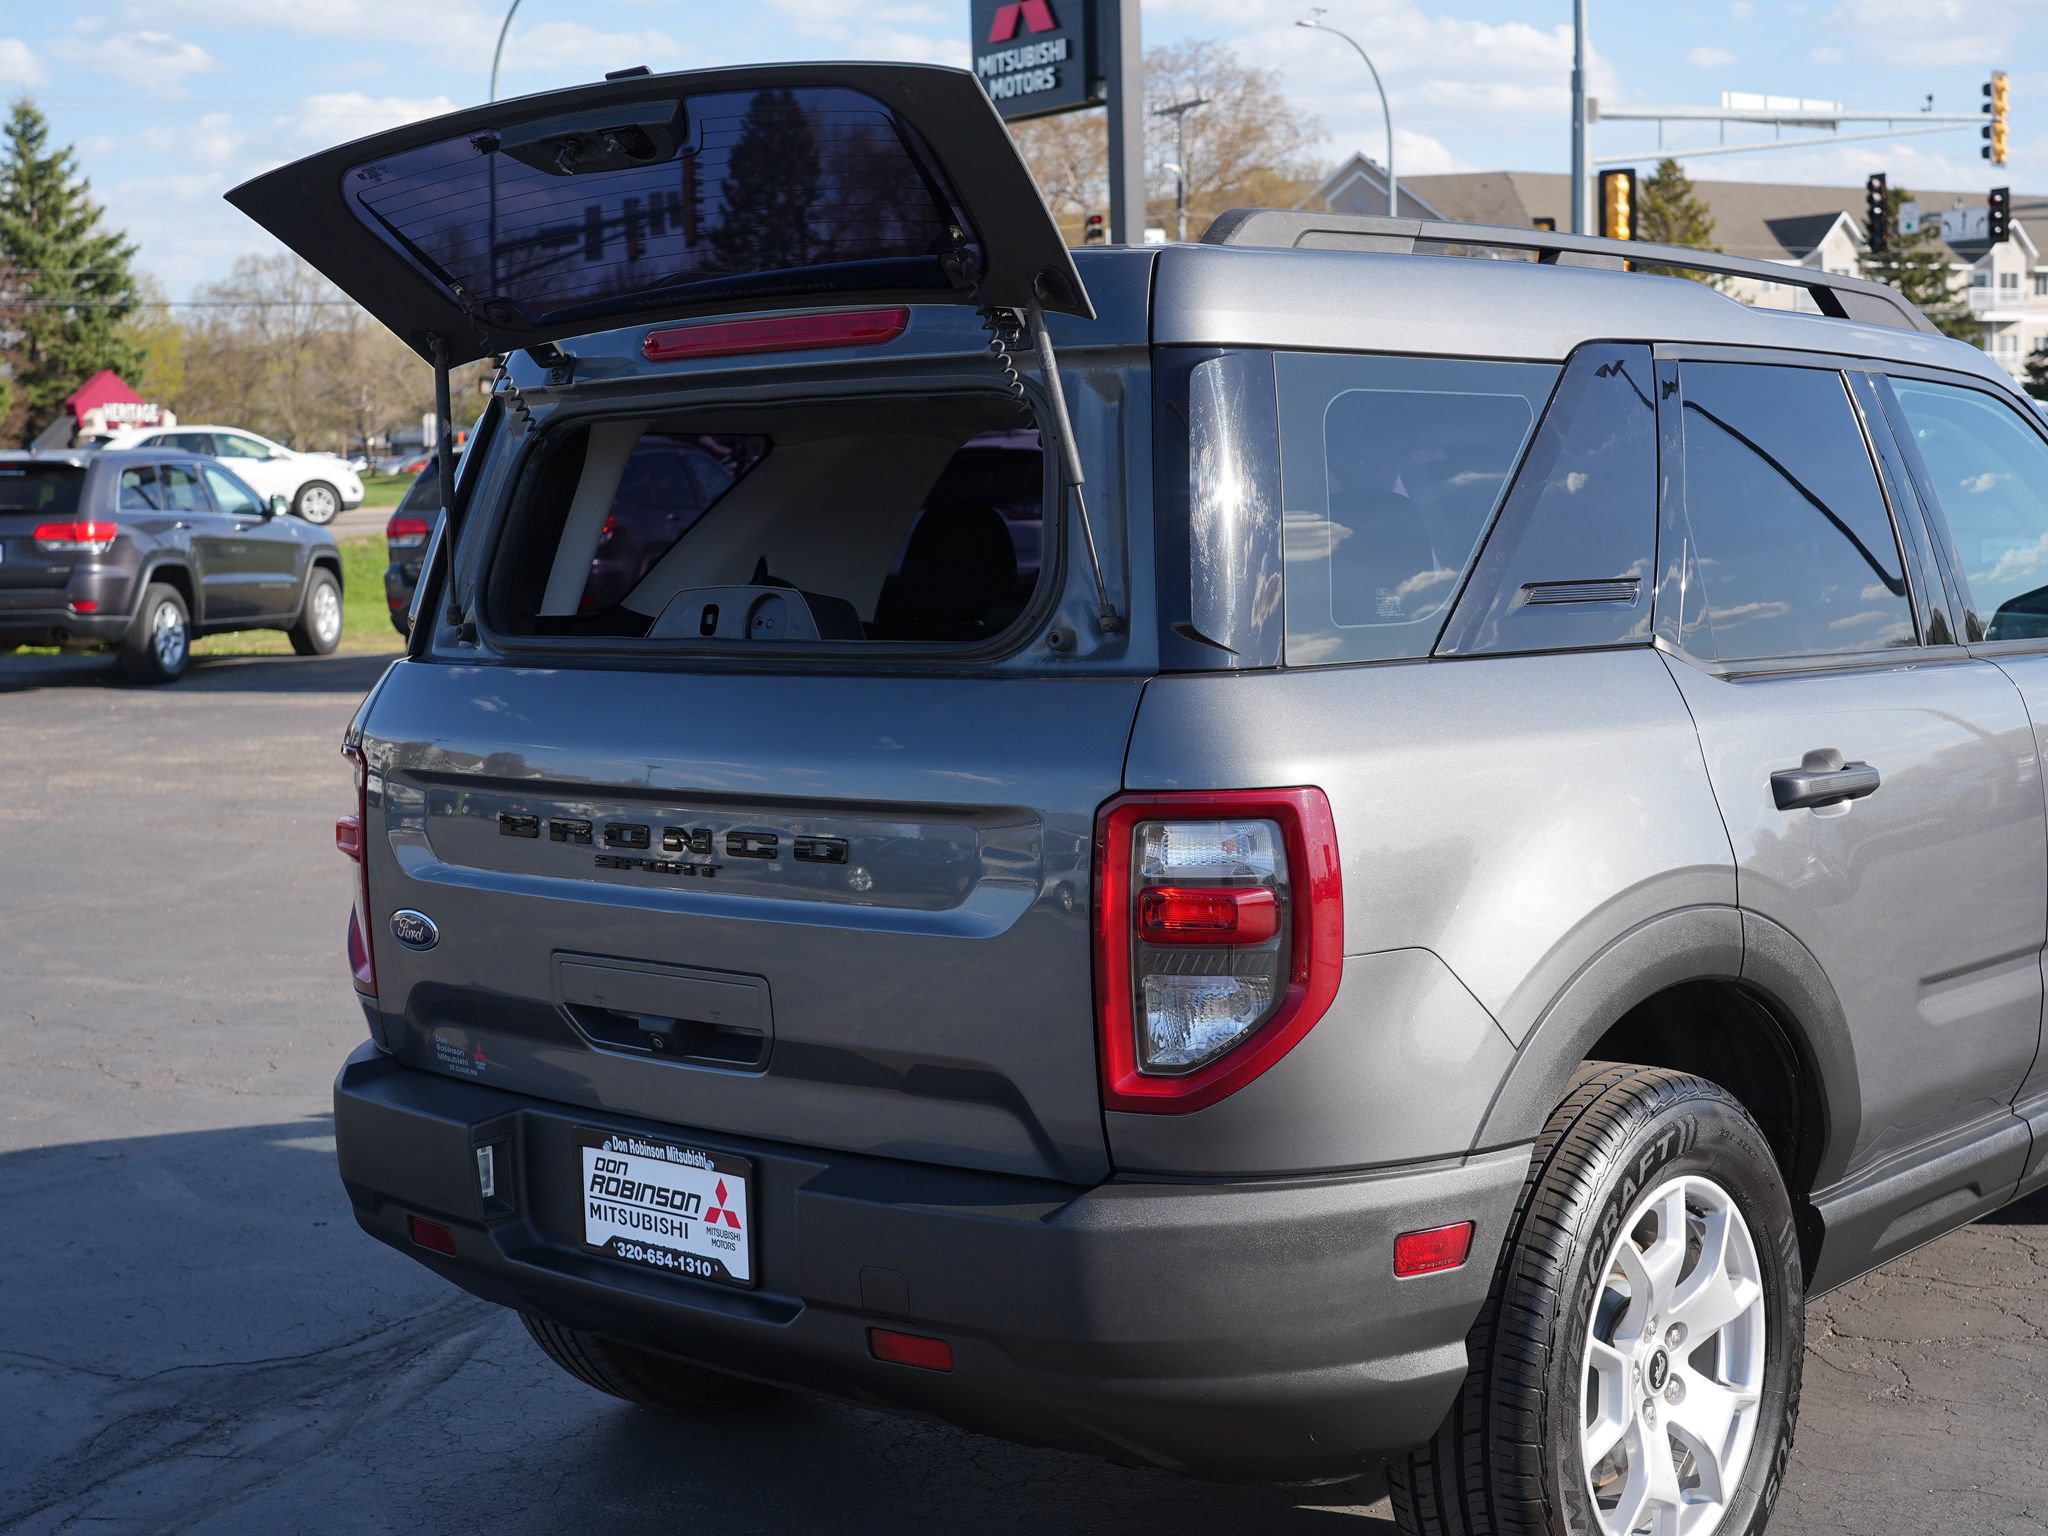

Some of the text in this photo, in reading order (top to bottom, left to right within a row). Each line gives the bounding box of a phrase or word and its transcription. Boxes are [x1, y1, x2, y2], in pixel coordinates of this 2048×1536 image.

[978, 38, 1067, 78] MITSUBISHI
[989, 66, 1056, 100] MOTORS
[103, 402, 158, 422] HERITAGE
[499, 811, 848, 864] BRONCO
[594, 854, 722, 877] SPORT
[397, 917, 424, 941] Ford
[436, 1044, 465, 1056] Robinson
[594, 1157, 629, 1176] DON
[612, 1135, 707, 1169] Don Robinson Mitsubishi
[589, 1173, 702, 1214] ROBINSON
[589, 1202, 689, 1240] MITSUBISHI
[706, 1227, 741, 1242] MITSUBISHI
[617, 1241, 712, 1277] 320-654-1310
[711, 1238, 736, 1252] MOTORS
